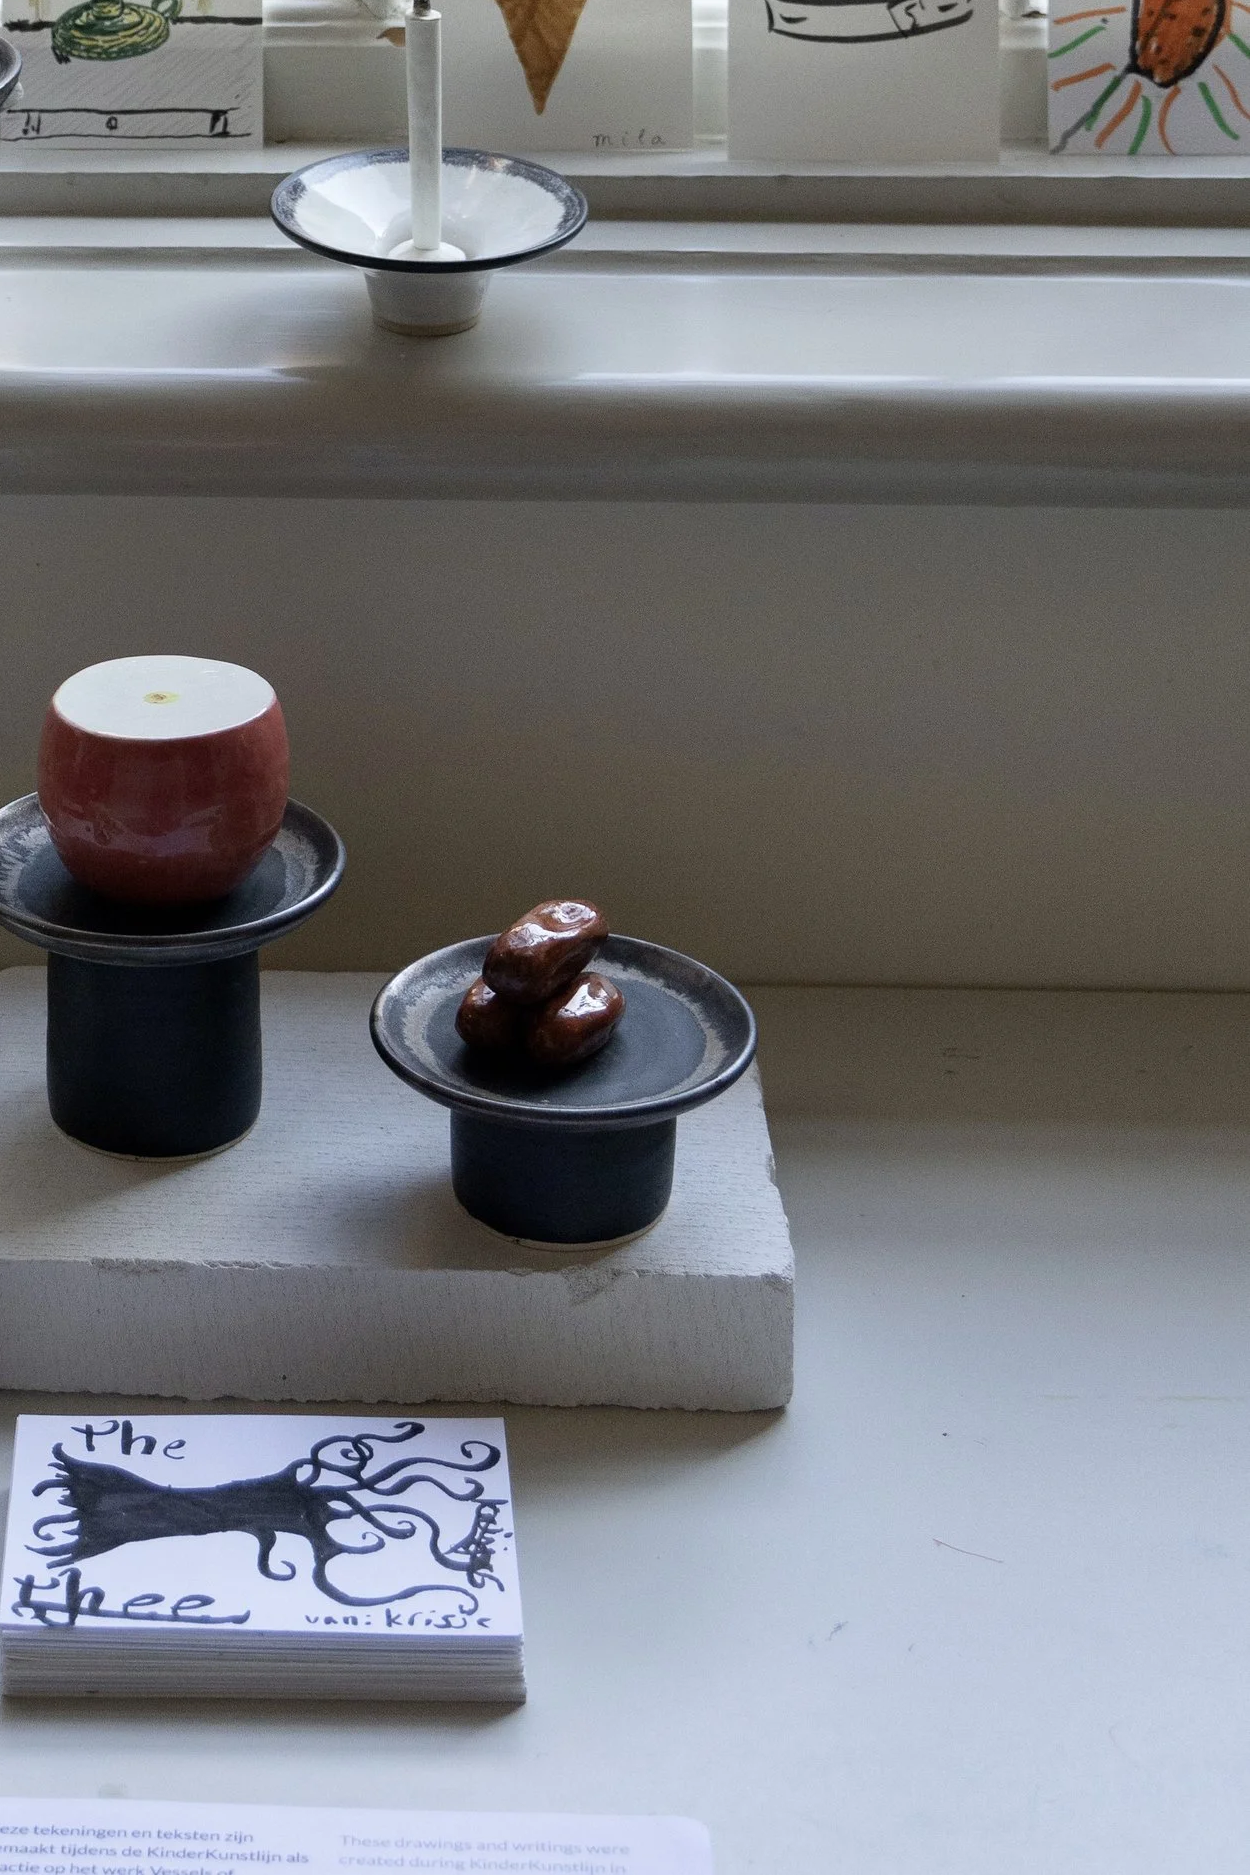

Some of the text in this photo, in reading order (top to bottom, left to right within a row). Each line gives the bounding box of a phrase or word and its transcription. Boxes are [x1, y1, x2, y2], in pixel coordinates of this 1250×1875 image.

[33, 1825, 127, 1839] tekeningen
[131, 1830, 151, 1838] en
[157, 1829, 220, 1841] teksten
[225, 1831, 254, 1844] zijn
[60, 1844, 117, 1857] tijdens
[121, 1846, 142, 1857] de
[147, 1846, 282, 1864] KinderKunstlijn
[286, 1851, 309, 1863] als
[340, 1834, 630, 1855] These drawings and writings were
[44, 1865, 66, 1875] op
[70, 1863, 97, 1875] het
[102, 1864, 145, 1875] werk
[338, 1855, 404, 1867] created
[409, 1857, 465, 1871] during
